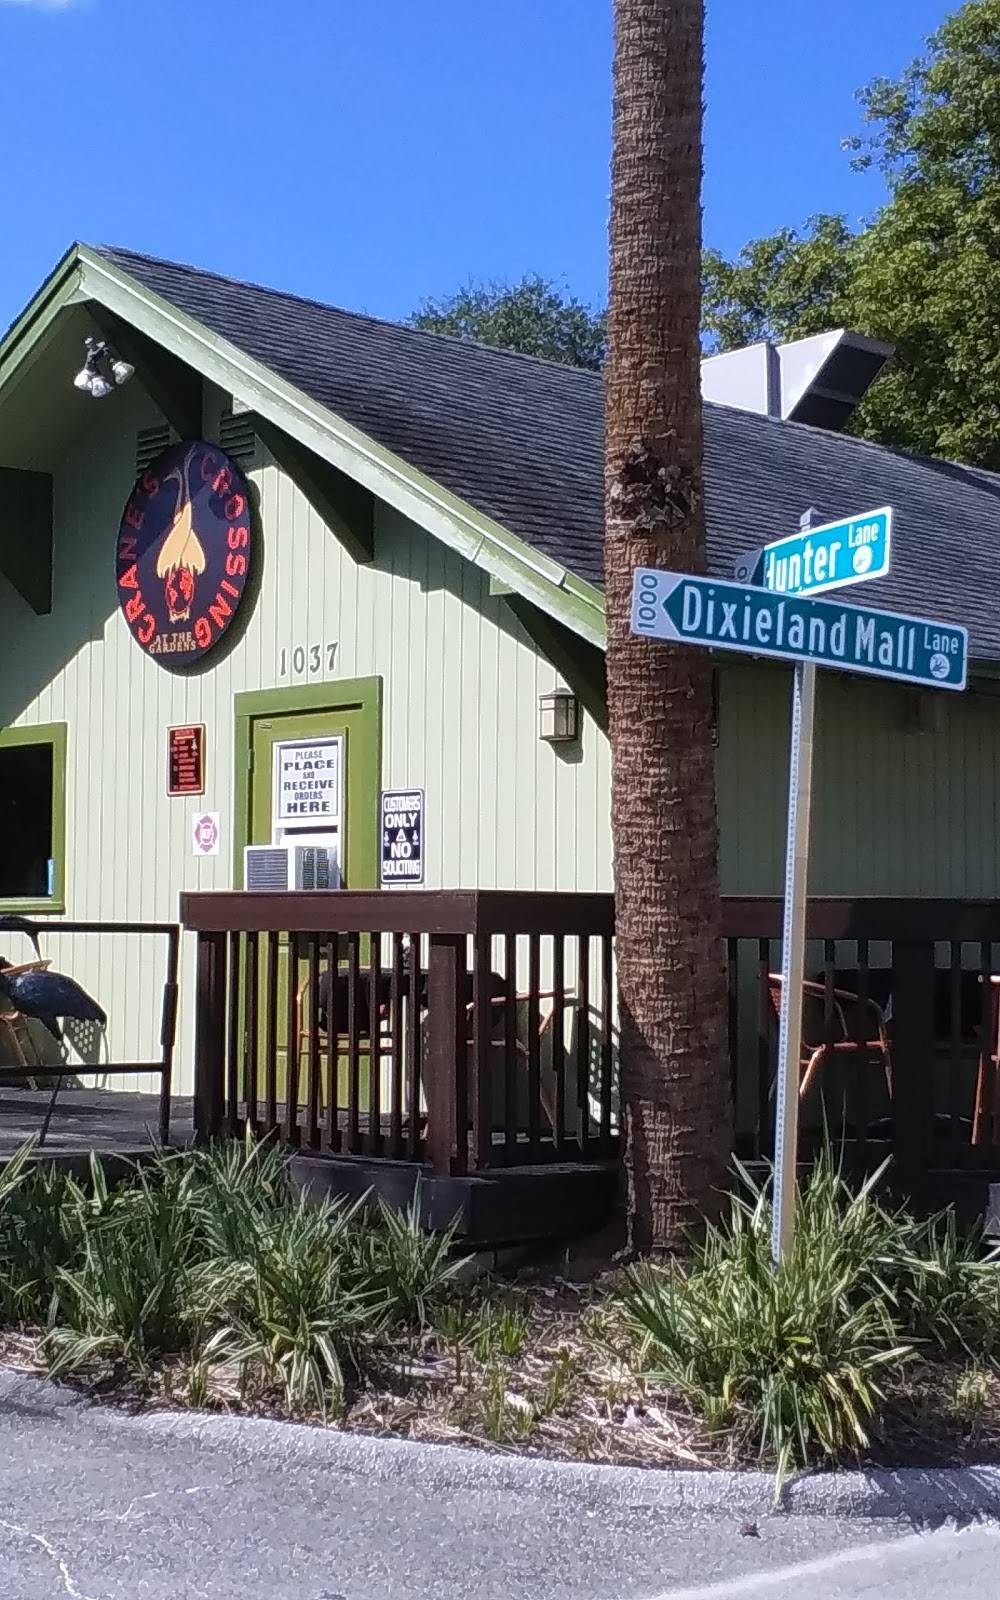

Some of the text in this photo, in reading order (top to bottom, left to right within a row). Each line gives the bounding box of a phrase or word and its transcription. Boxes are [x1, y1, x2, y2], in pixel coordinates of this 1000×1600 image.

[848, 522, 880, 549] Lane
[193, 451, 248, 648] CROSSING
[637, 574, 658, 629] 1000
[681, 585, 960, 671] Dixieland Mall Lane
[153, 631, 192, 646] AT THE
[148, 640, 197, 654] GARDENS
[280, 641, 338, 676] 1037
[295, 750, 323, 761] PLEASE
[283, 759, 335, 772] PLACE
[283, 779, 335, 791] RECEIVE
[294, 791, 323, 801] ORDERS
[286, 800, 330, 814] HERE
[384, 812, 418, 829] ONLY
[390, 841, 412, 859] NO
[382, 860, 420, 876] SOLICITING
